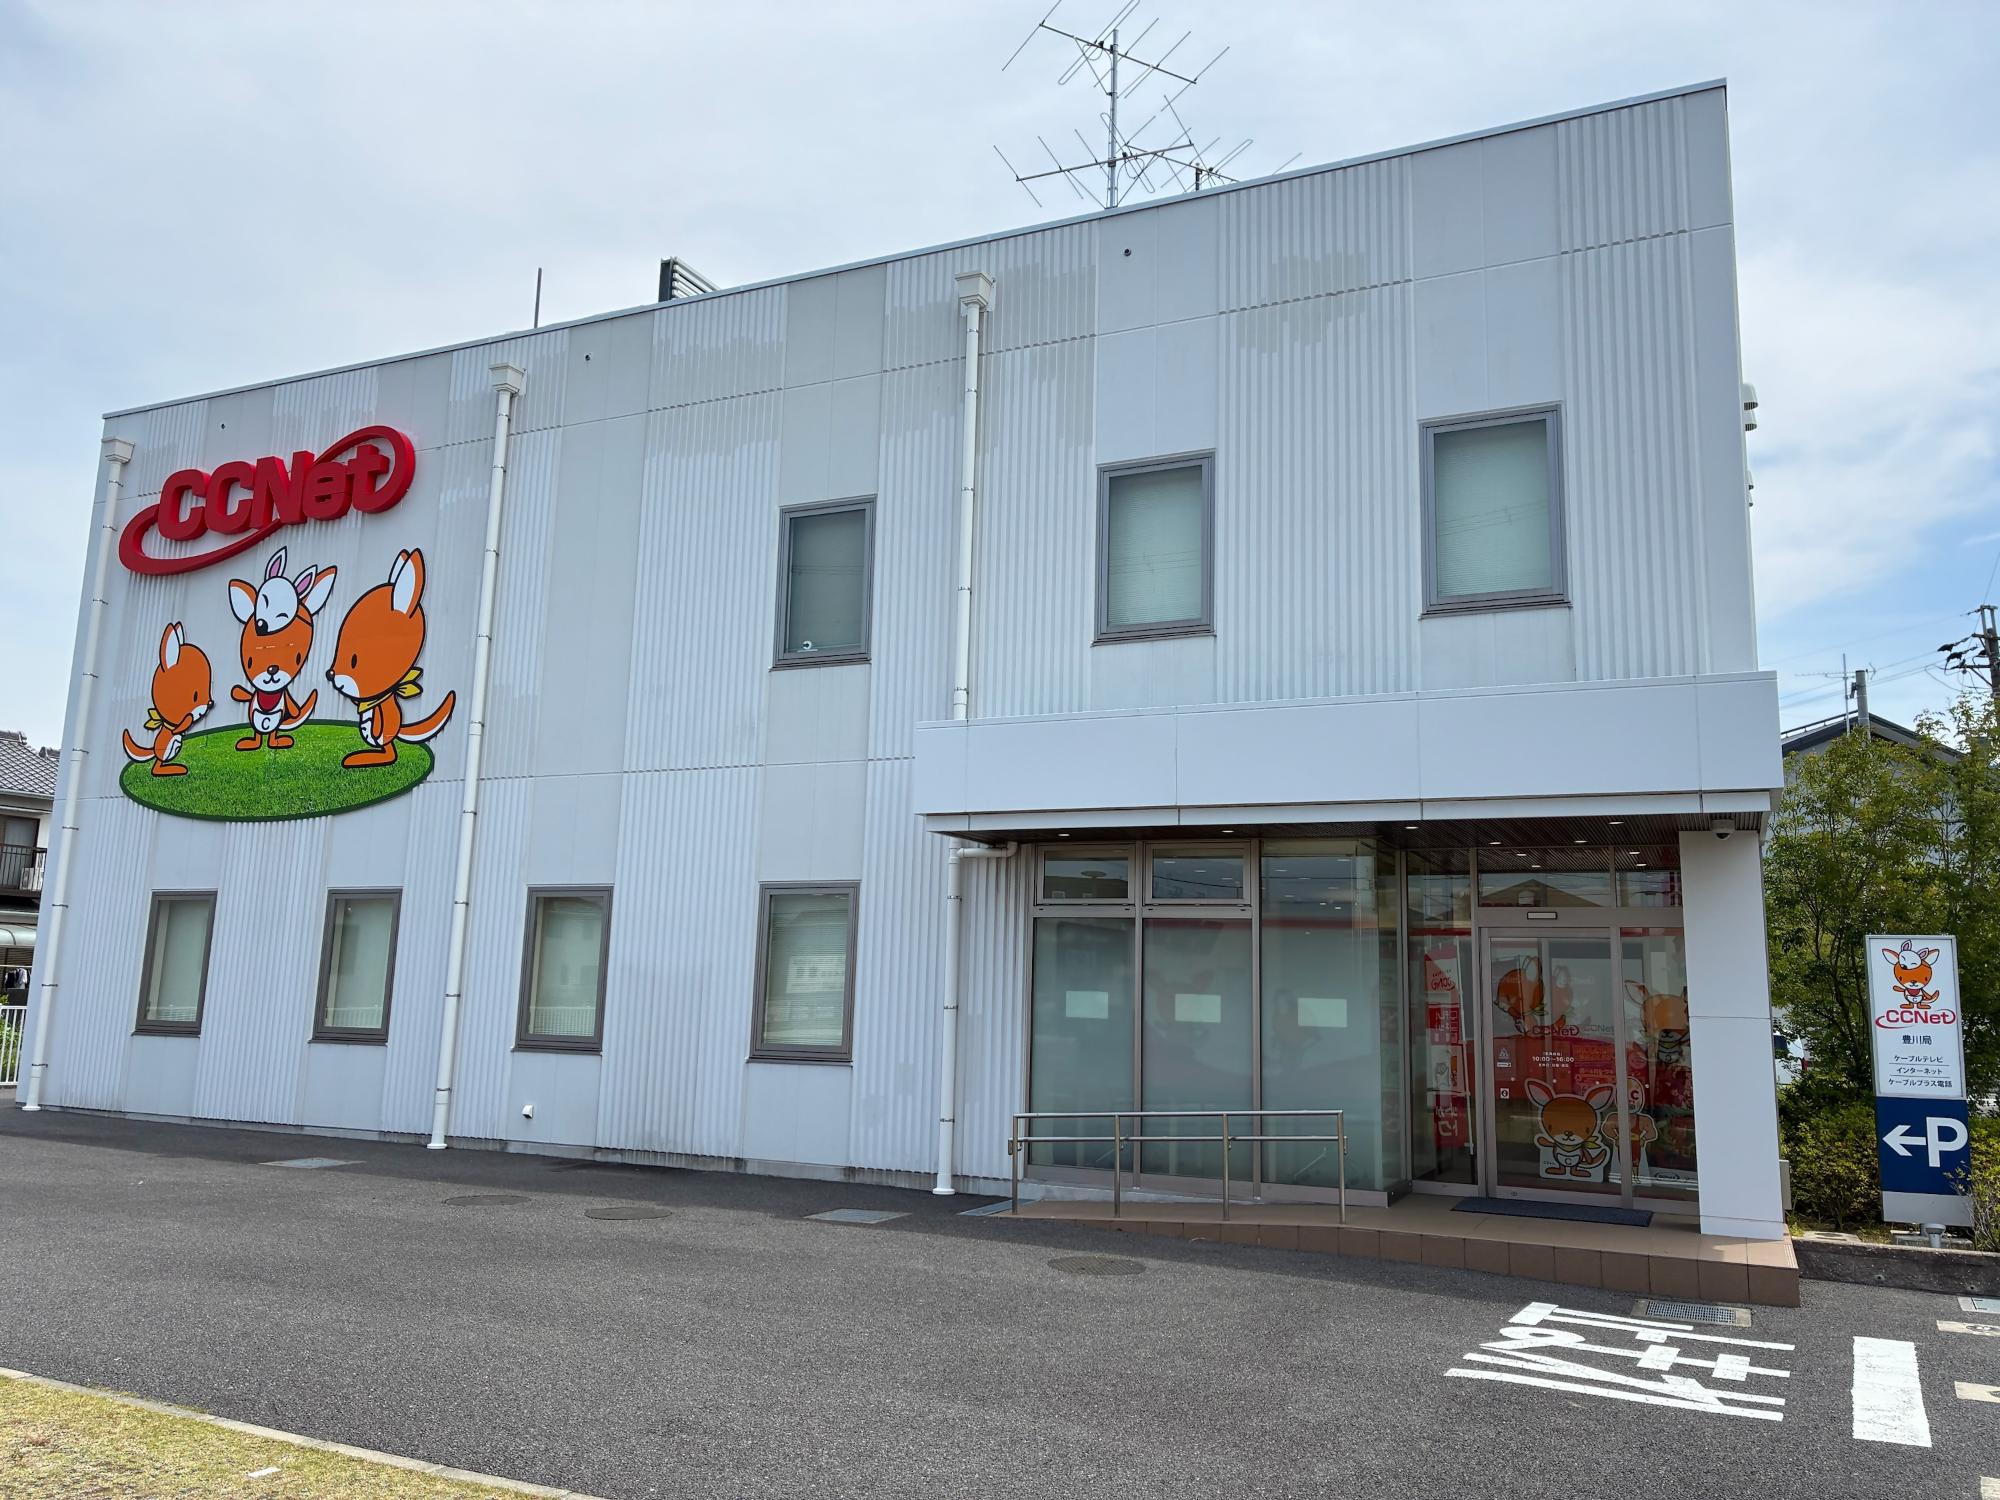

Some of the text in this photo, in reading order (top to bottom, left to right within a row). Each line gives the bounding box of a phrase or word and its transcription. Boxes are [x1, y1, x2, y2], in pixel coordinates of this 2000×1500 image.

[154, 434, 408, 541] CCNet
[1885, 1009, 1956, 1025] CCNet
[1902, 1035, 1932, 1045] 豊川局
[1894, 1055, 1943, 1063] ケーブルテレビ
[1896, 1067, 1943, 1075] インターネット
[1888, 1078, 1952, 1088] ケーブルプラス電話
[1926, 1117, 1968, 1168] P
[1443, 1301, 1795, 1421] 止まれ
